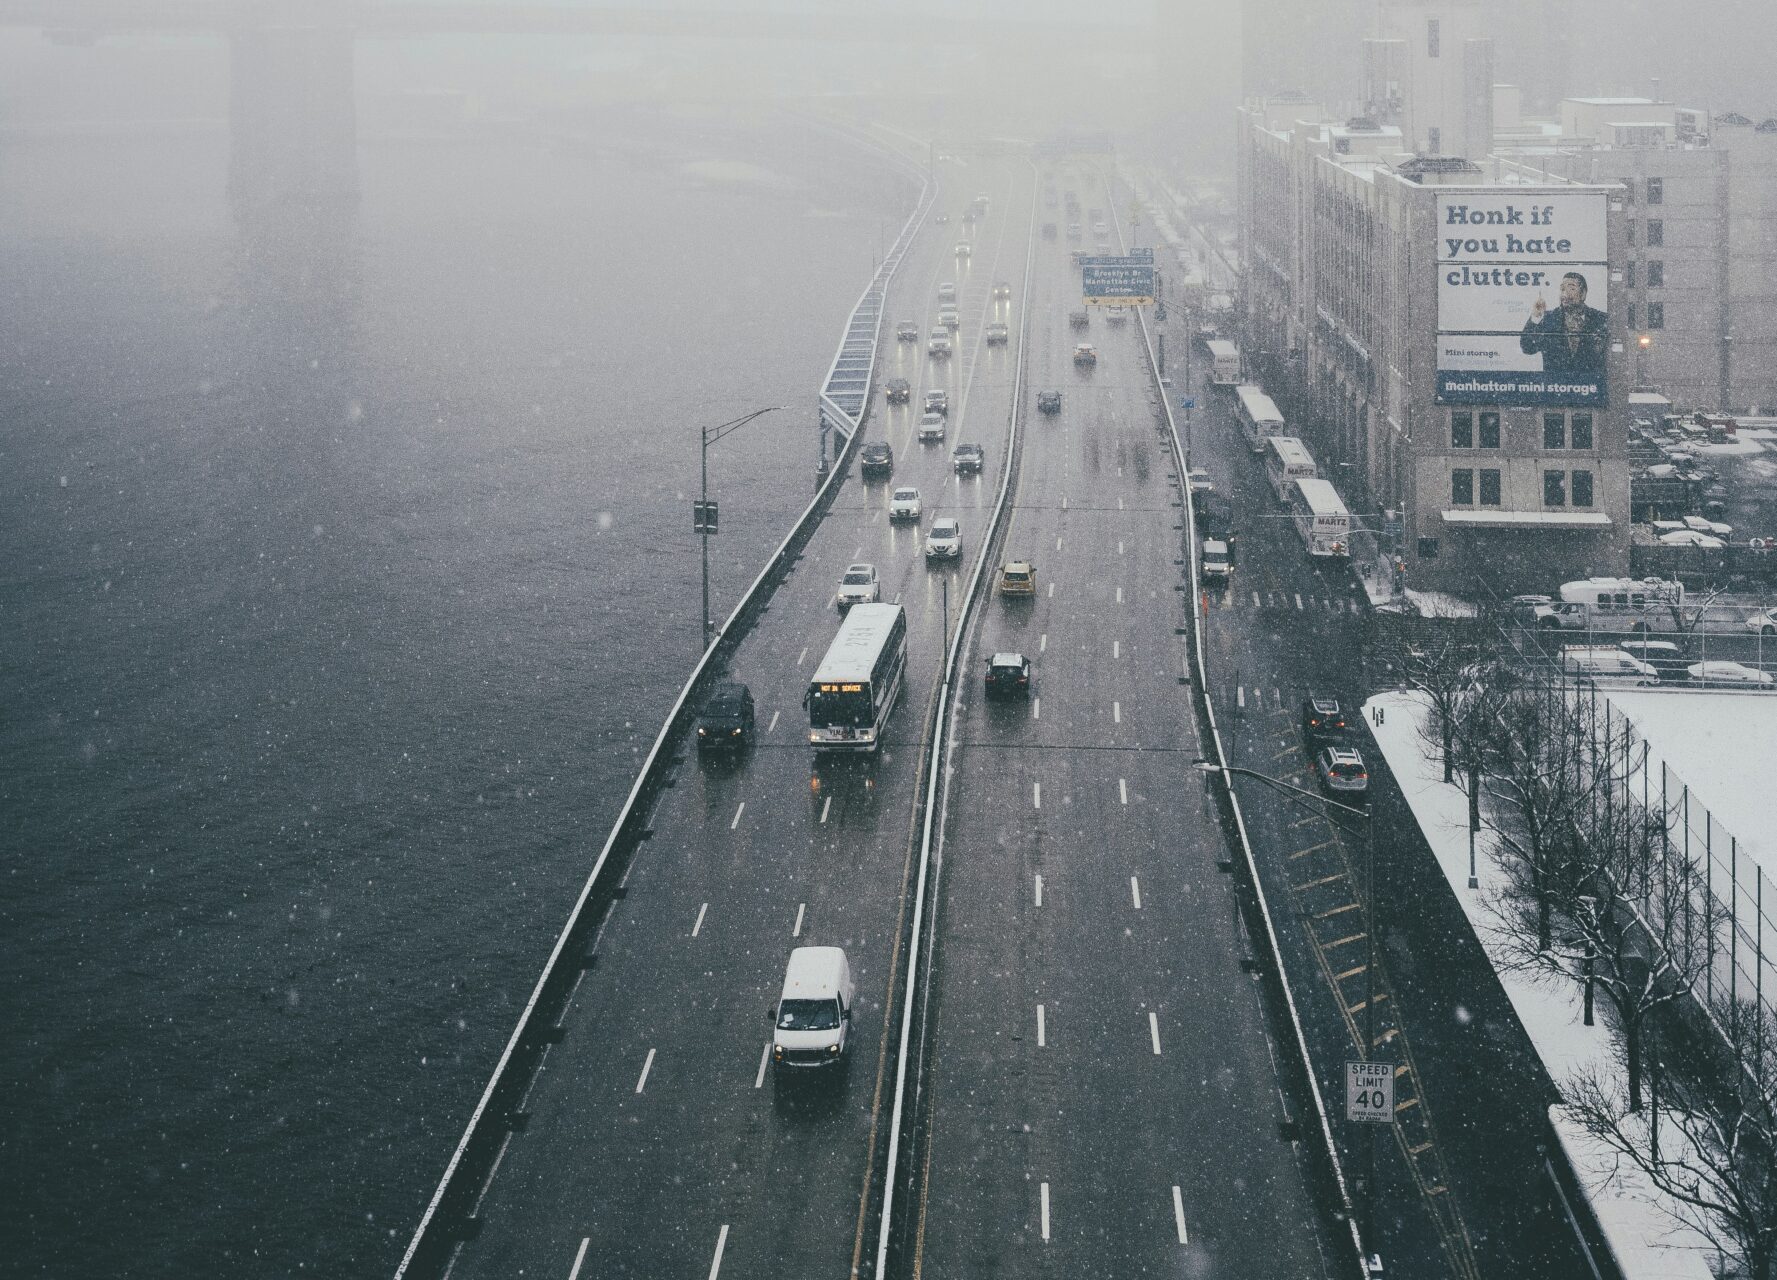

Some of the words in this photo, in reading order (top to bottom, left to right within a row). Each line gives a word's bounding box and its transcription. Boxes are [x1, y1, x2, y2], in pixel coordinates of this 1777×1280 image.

[1446, 205, 1523, 225] Honk
[1531, 206, 1554, 225] if
[1446, 238, 1499, 258] you
[1506, 234, 1571, 253] hate
[1446, 267, 1551, 287] clutter.
[1445, 379, 1516, 392] manhattan
[1518, 381, 1545, 392] mini
[1548, 382, 1597, 394] storage
[1288, 468, 1314, 476] MARTZ
[1318, 518, 1347, 526] MARTZ
[1352, 1064, 1389, 1076] SPEED
[1356, 1077, 1385, 1088] LIMIT
[1355, 1090, 1385, 1109] 40
